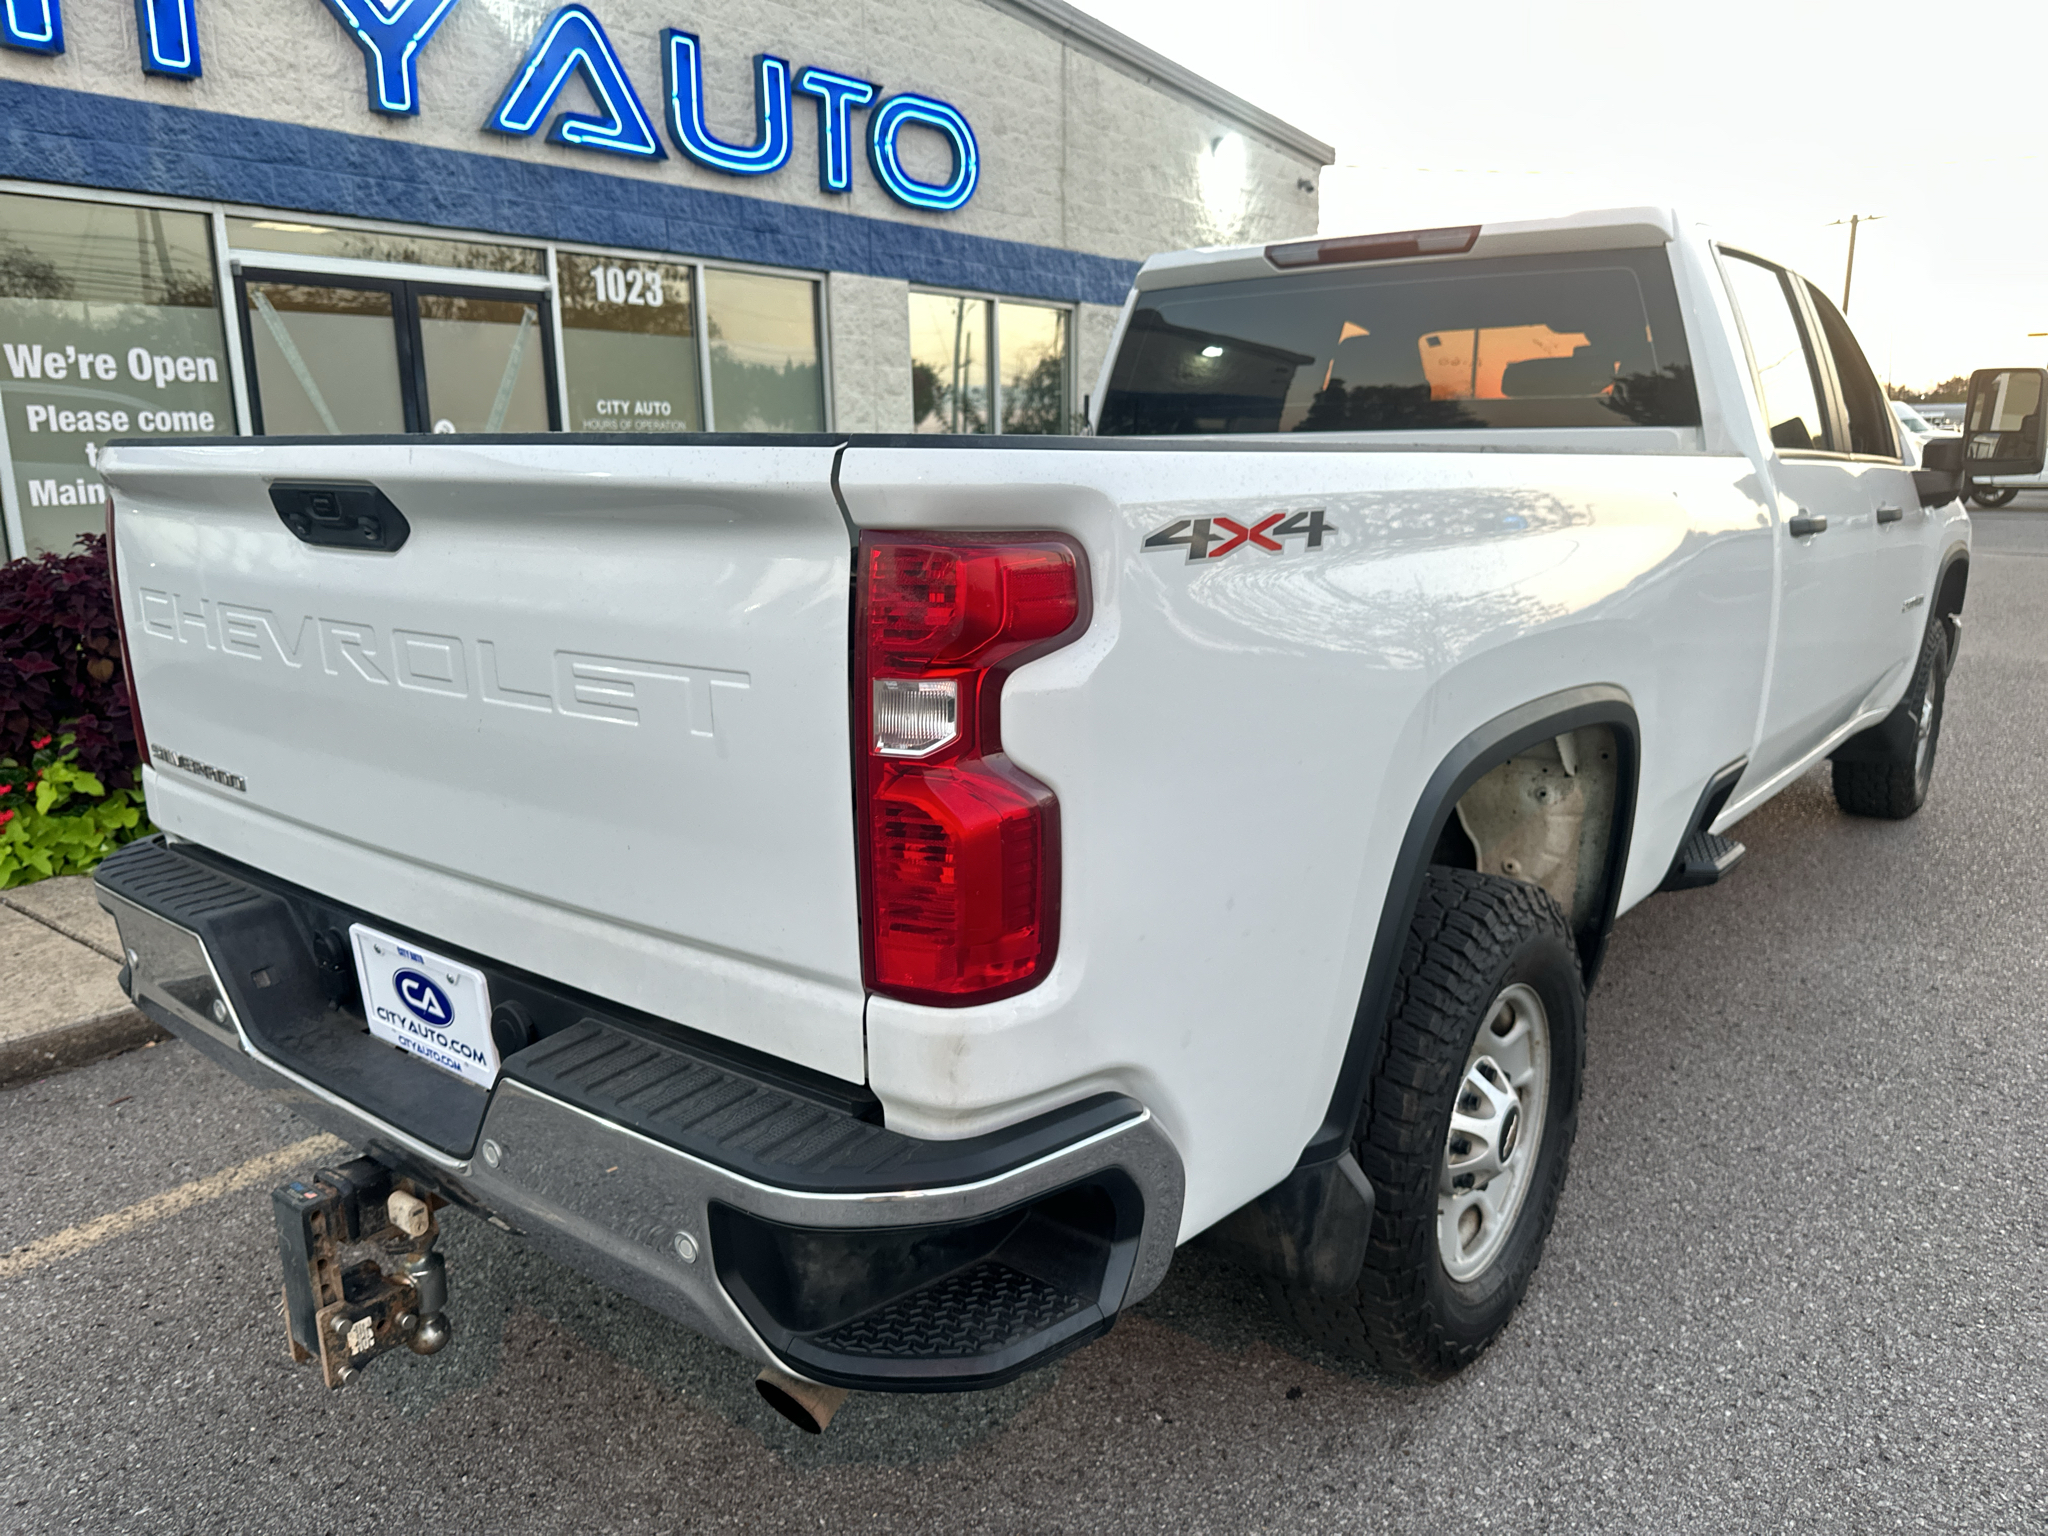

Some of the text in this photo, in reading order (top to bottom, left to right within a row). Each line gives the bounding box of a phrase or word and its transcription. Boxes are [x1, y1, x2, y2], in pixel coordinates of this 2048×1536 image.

[480, 3, 980, 212] AUTO
[590, 265, 664, 308] 1023
[3, 343, 219, 388] We're Open
[26, 404, 215, 432] Please come
[582, 418, 618, 430] HOURS
[619, 419, 632, 430] OF
[596, 399, 672, 416] CITY AUTO
[28, 478, 106, 507] Main
[140, 587, 752, 737] CHEVROLET
[376, 1006, 487, 1066] CITY AUTO.COM
